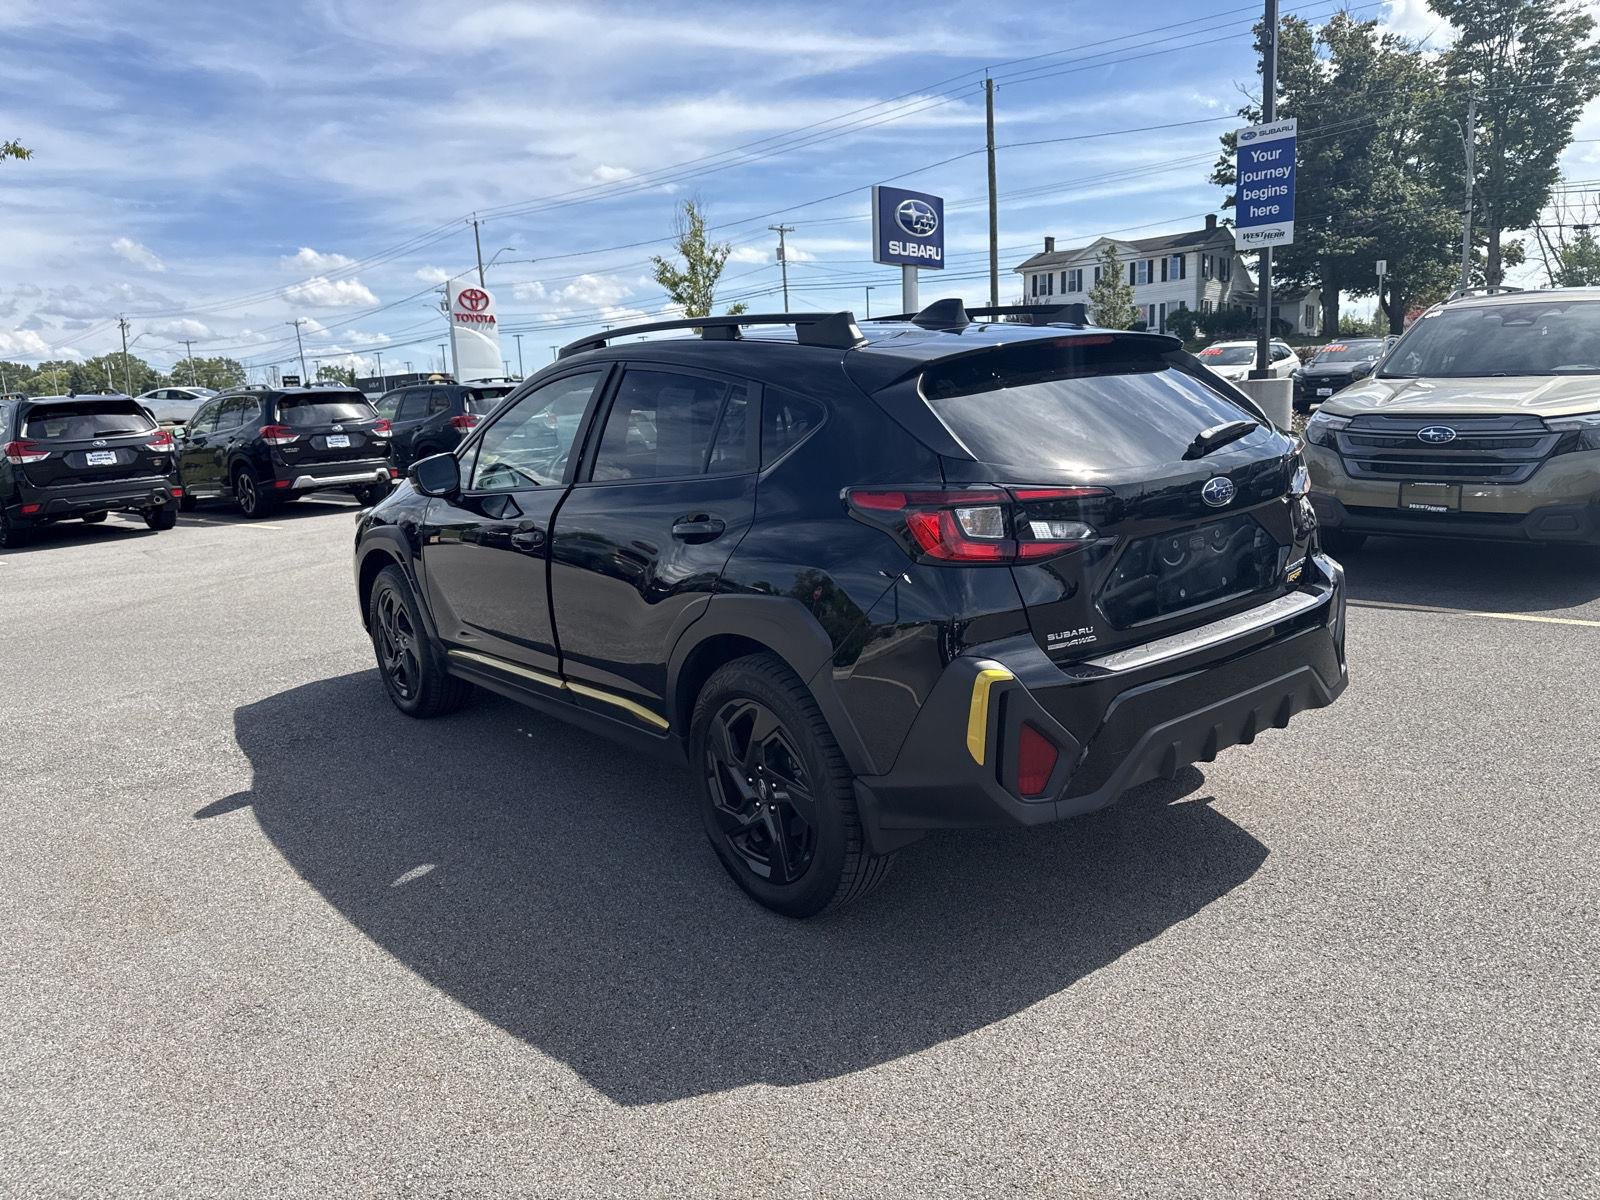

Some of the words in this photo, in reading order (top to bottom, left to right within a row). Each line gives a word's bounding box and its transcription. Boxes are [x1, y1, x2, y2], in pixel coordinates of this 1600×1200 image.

[1259, 125, 1293, 136] SUBARU
[1251, 148, 1282, 163] Your
[1240, 166, 1291, 185] journey
[1243, 185, 1288, 200] begins
[1250, 204, 1280, 218] here
[888, 240, 941, 260] SUBARU
[454, 313, 496, 324] TOYOTA
[1047, 626, 1093, 640] SUBARU
